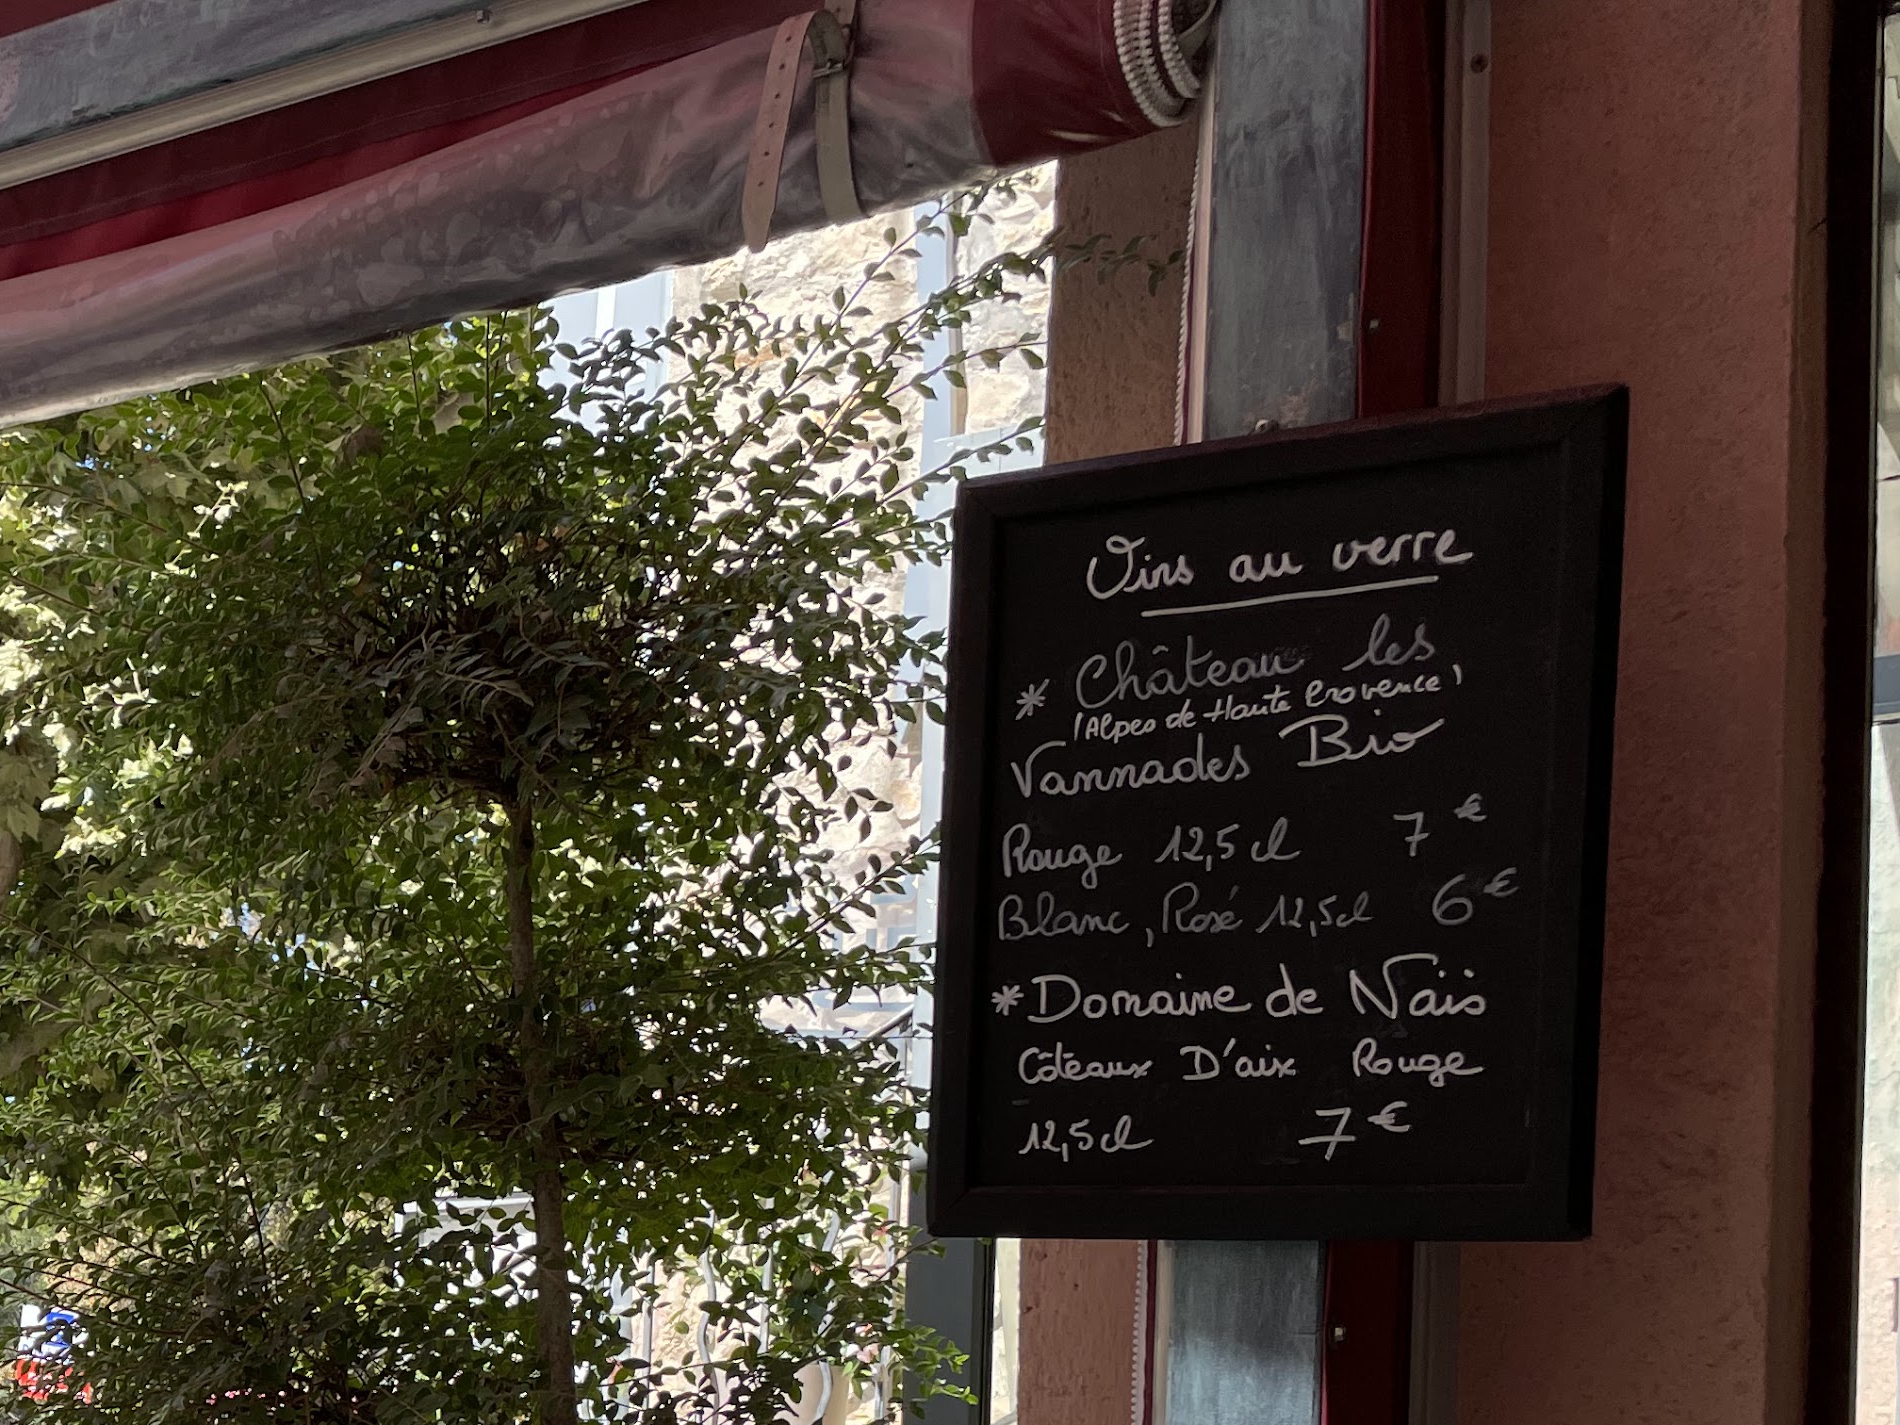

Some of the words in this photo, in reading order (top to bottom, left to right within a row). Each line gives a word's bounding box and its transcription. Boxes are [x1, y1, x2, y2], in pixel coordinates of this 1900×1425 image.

[1086, 535, 1194, 599] Vins
[1229, 552, 1304, 582] au
[1332, 529, 1474, 571] verre
[1075, 635, 1305, 708] Château
[1342, 614, 1436, 671] les
[1165, 699, 1197, 729] de
[1202, 685, 1292, 723] Haute
[1010, 733, 1251, 798] Vannades
[1278, 709, 1446, 767] Bio
[1001, 823, 1123, 889] Rouge
[1162, 883, 1244, 934] Rosé
[1265, 963, 1325, 1017] de
[1348, 953, 1488, 1019] Naïs
[1179, 1038, 1297, 1081] D'aix
[1351, 1037, 1486, 1087] Rouge
